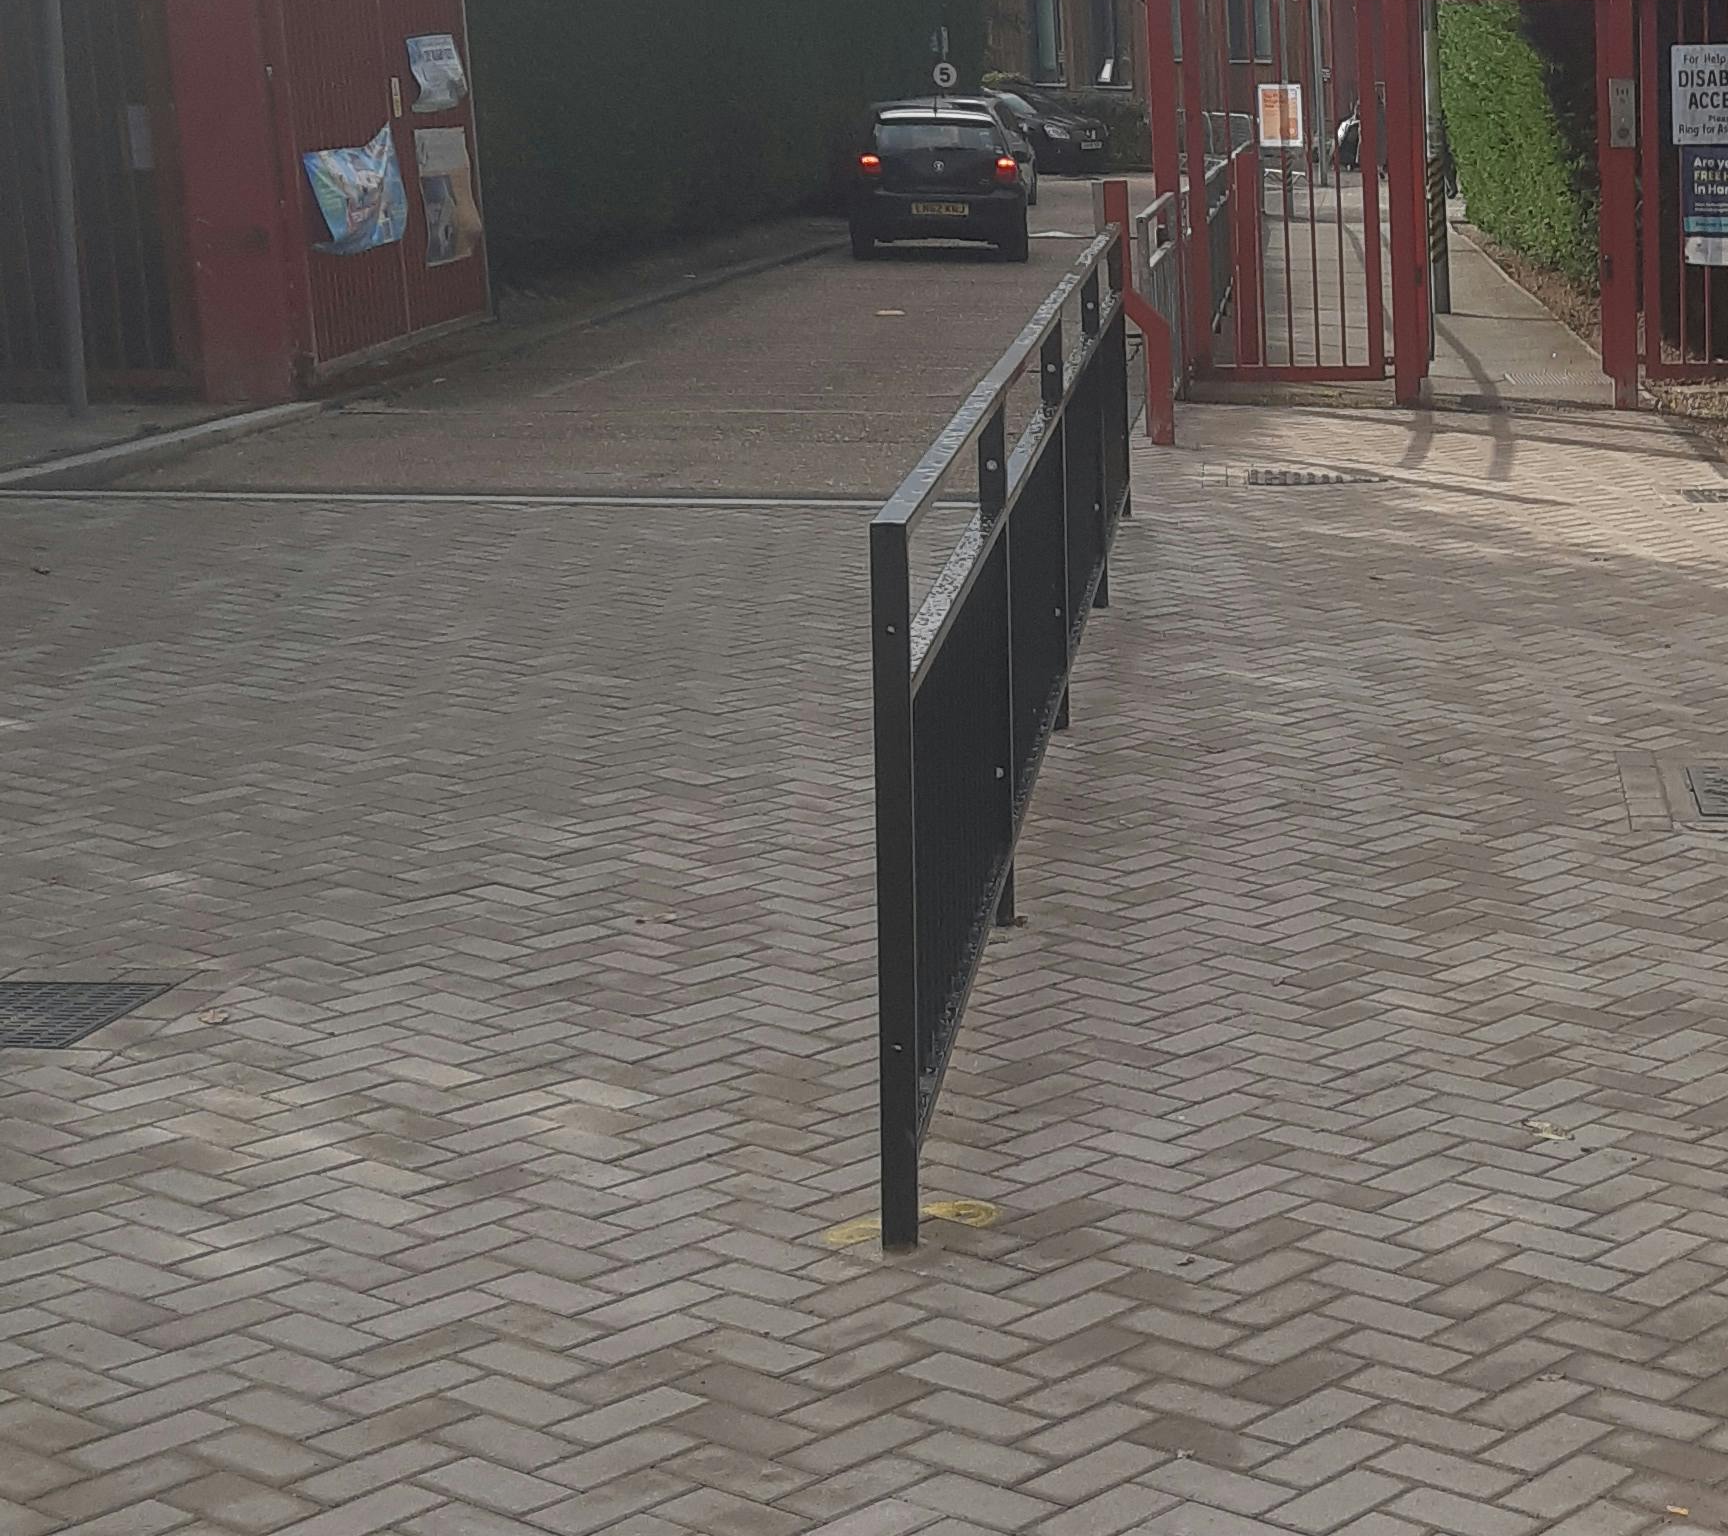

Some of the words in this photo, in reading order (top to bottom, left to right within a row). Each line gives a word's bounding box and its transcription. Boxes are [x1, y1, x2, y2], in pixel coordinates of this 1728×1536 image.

[1683, 54, 1699, 64] For
[1704, 53, 1726, 66] Help
[939, 67, 951, 83] 5
[1679, 124, 1699, 136] Ring
[1703, 124, 1715, 134] for
[1693, 157, 1715, 168] Are
[1694, 170, 1720, 181] FREE
